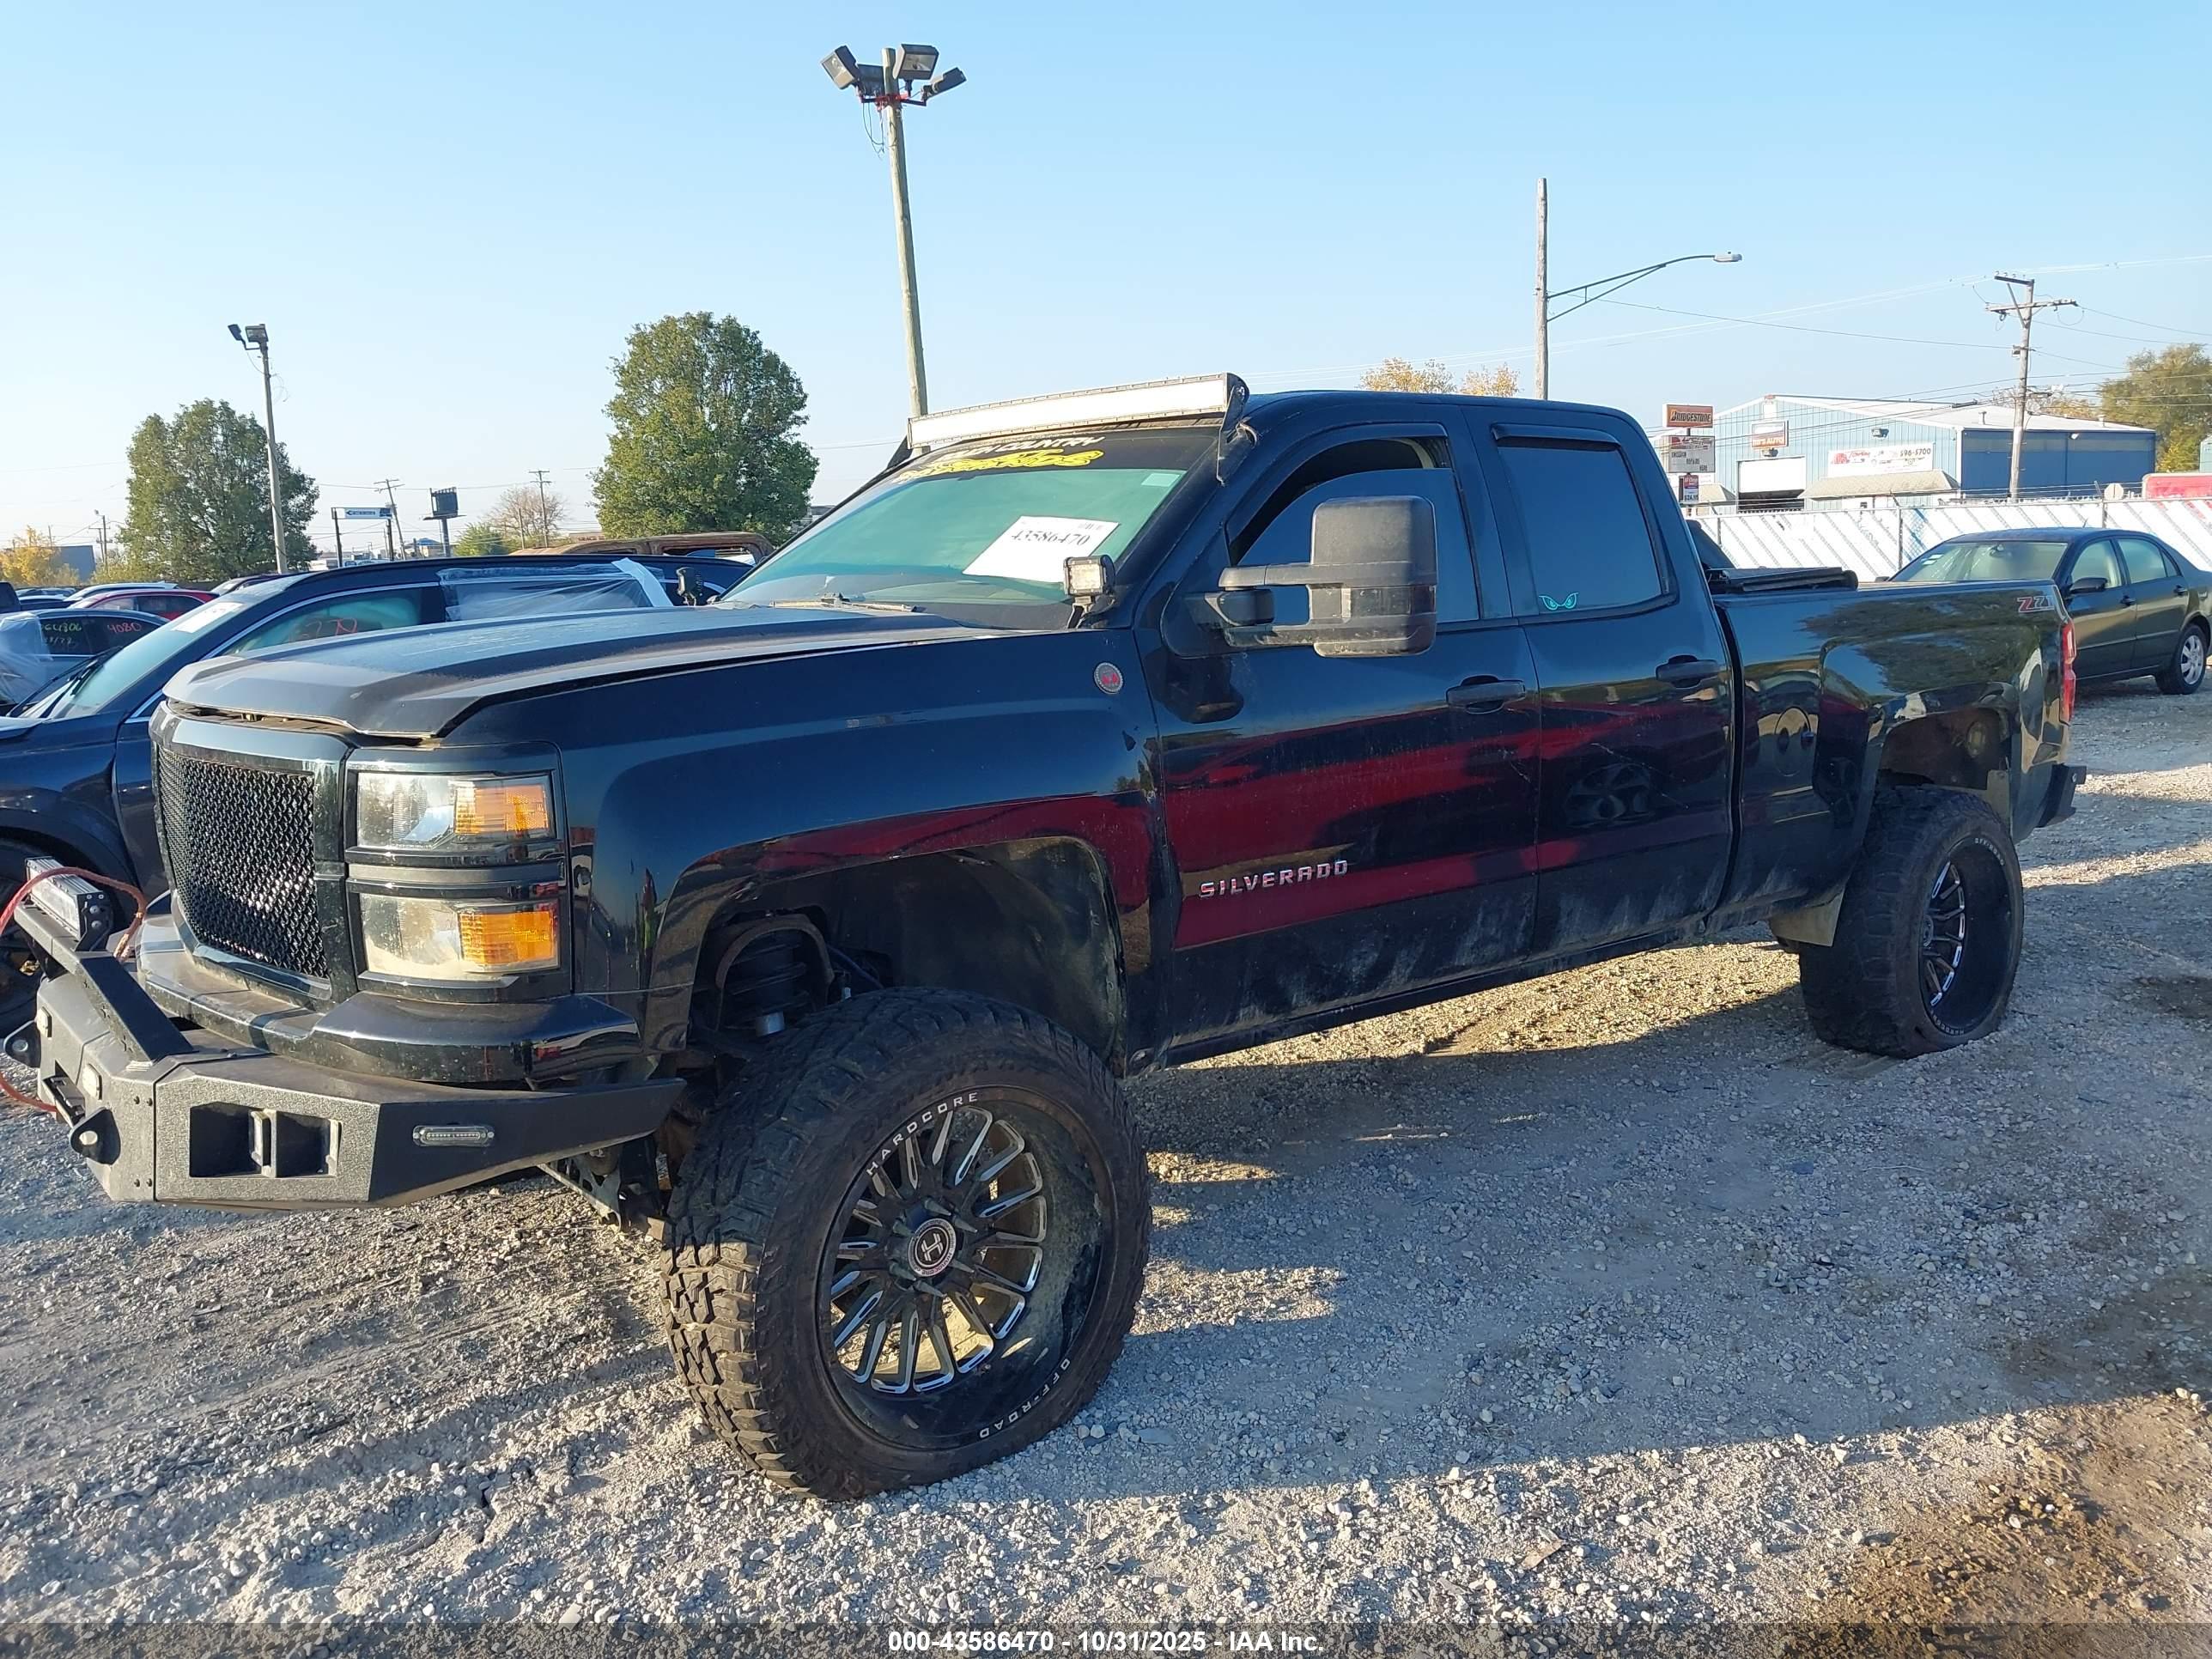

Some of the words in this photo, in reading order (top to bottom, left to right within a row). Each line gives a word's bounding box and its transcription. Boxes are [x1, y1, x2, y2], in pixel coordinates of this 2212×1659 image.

[1670, 410, 1711, 422] BRIDGESTONE
[1011, 529, 1091, 545] 43586470
[2017, 595, 2055, 612] Z71
[1199, 860, 1348, 898] SILVERADO
[866, 1091, 979, 1176] HARDCORE
[979, 1358, 1072, 1438] OFF-ROAD
